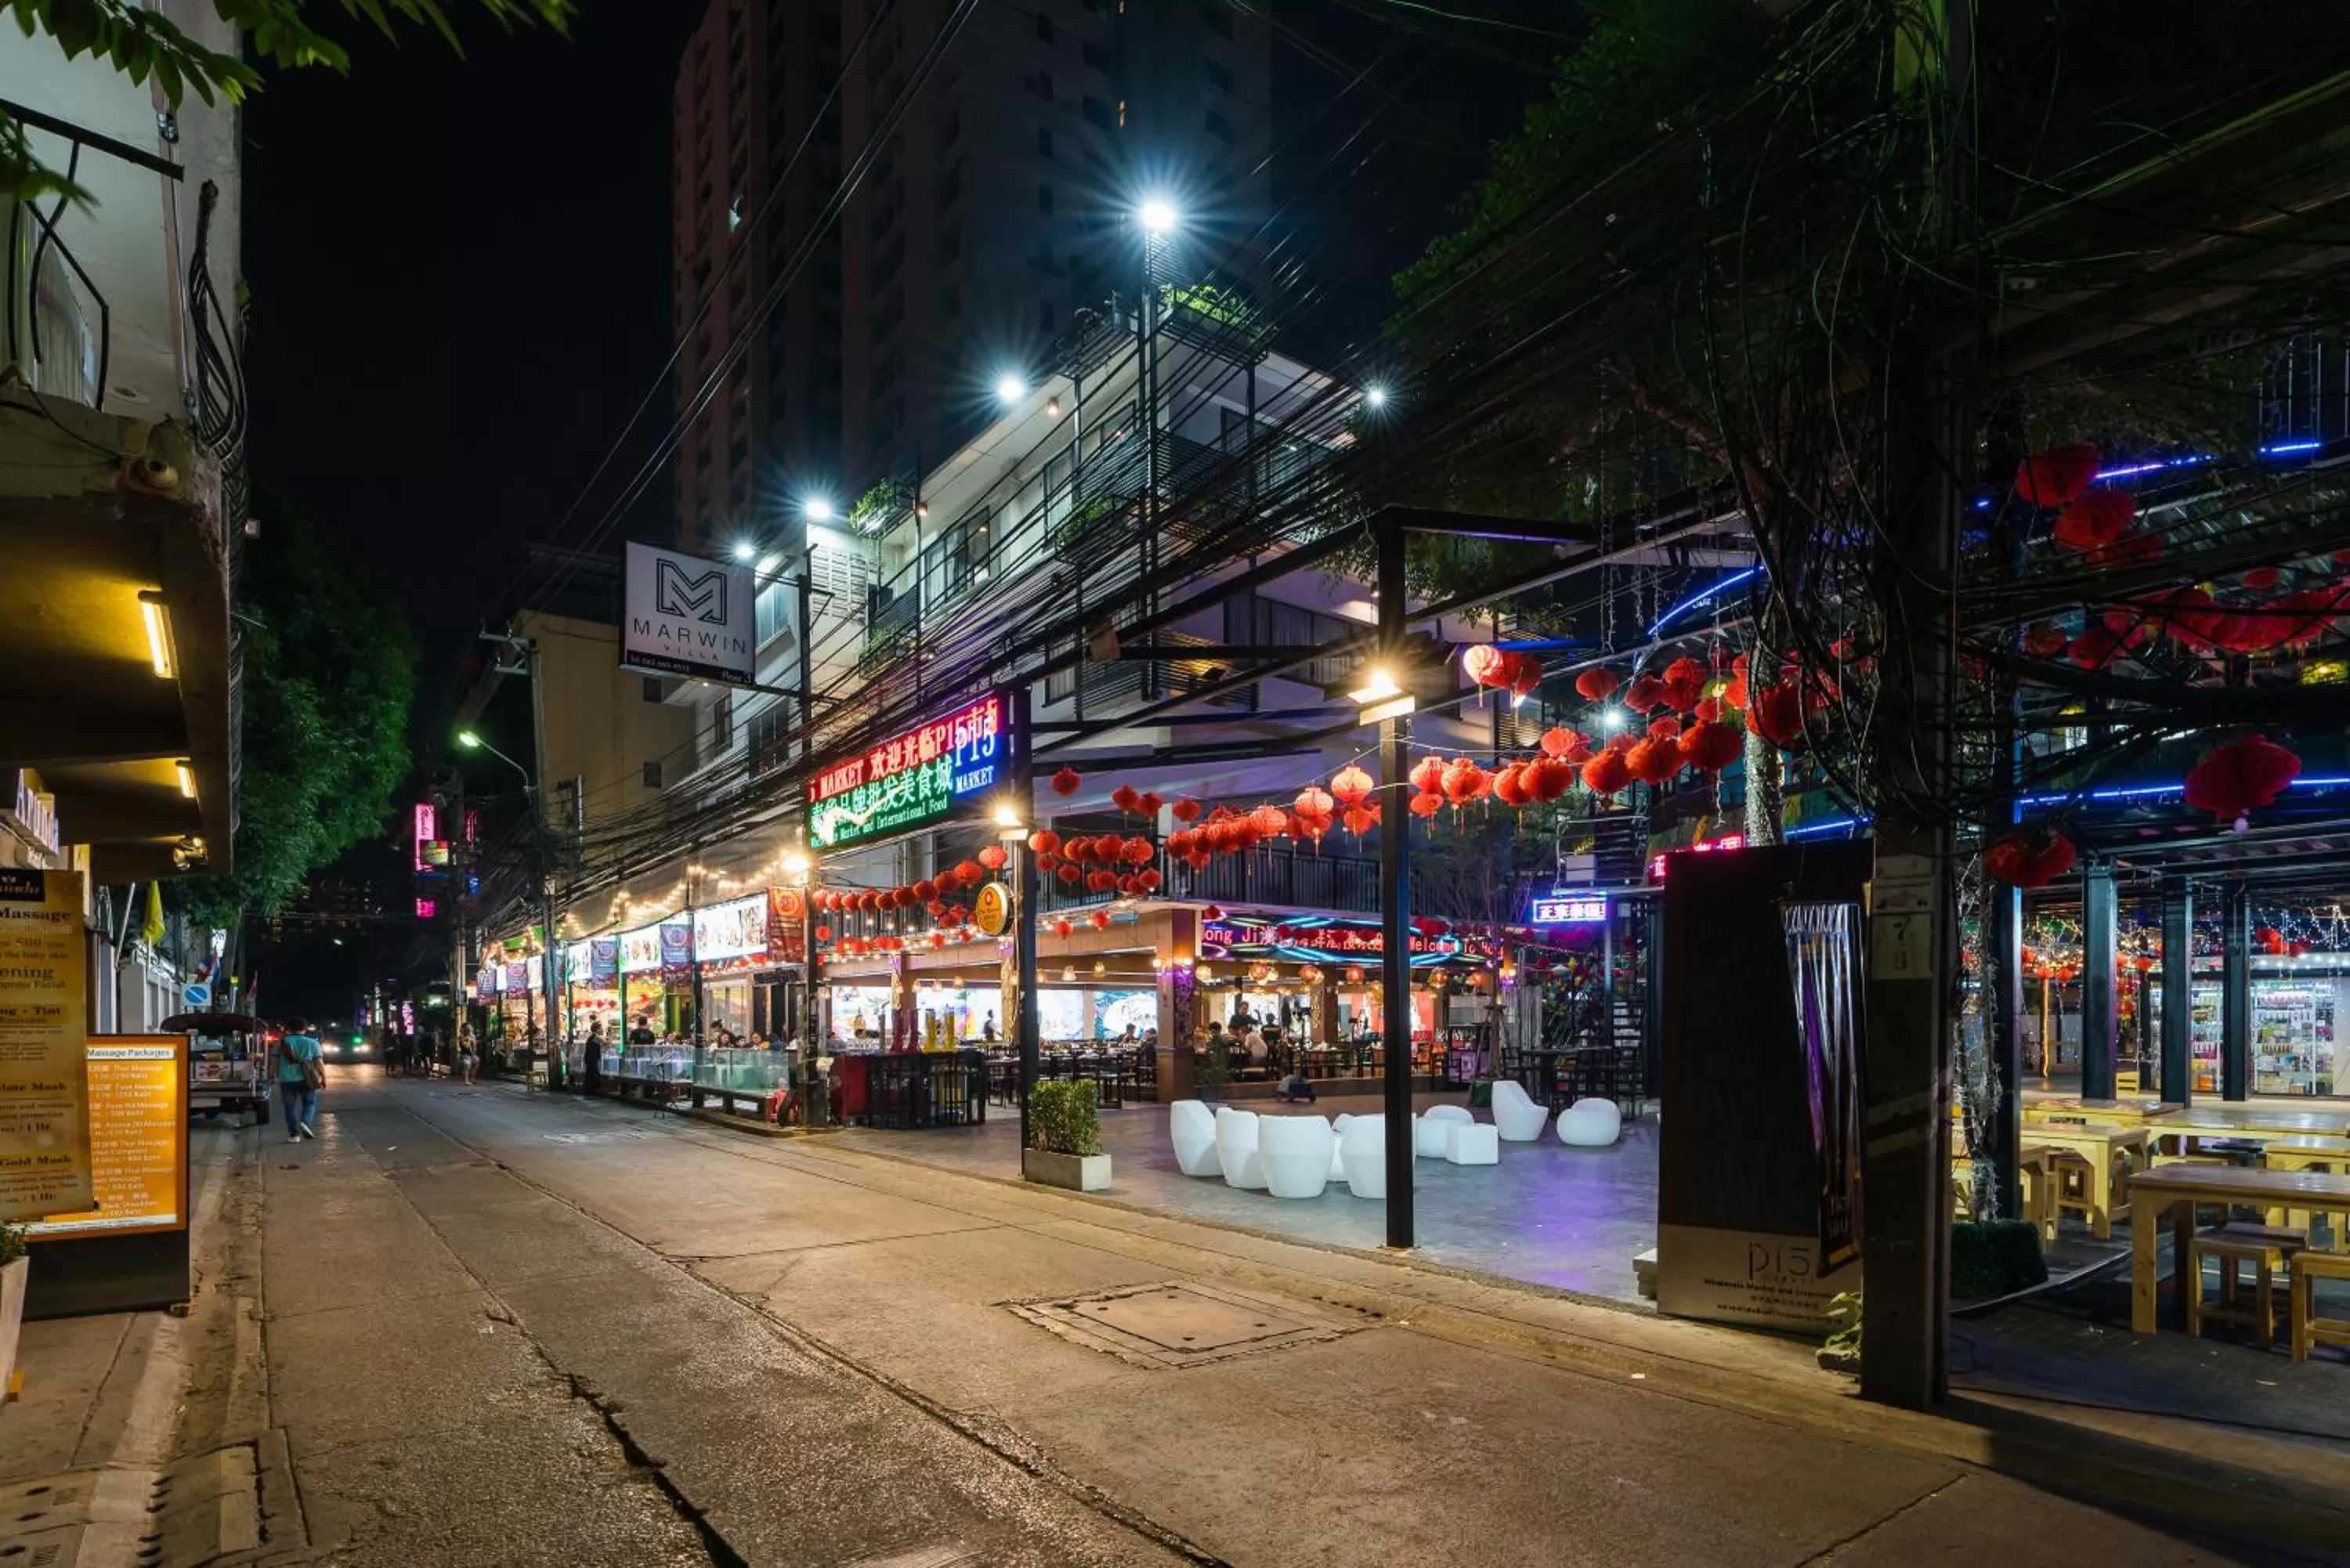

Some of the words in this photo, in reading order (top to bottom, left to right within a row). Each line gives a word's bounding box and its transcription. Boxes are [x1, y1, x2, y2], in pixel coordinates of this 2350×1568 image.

[633, 617, 747, 655] MARWIN
[663, 643, 719, 662] VILLA
[821, 757, 864, 798] MARKET
[955, 766, 995, 795] MARKET
[877, 801, 926, 829] International
[929, 794, 948, 814] Food
[0, 908, 73, 923] Massage
[88, 1049, 126, 1057] Massage
[128, 1049, 170, 1057] Packages
[1749, 1241, 1811, 1281] P15
